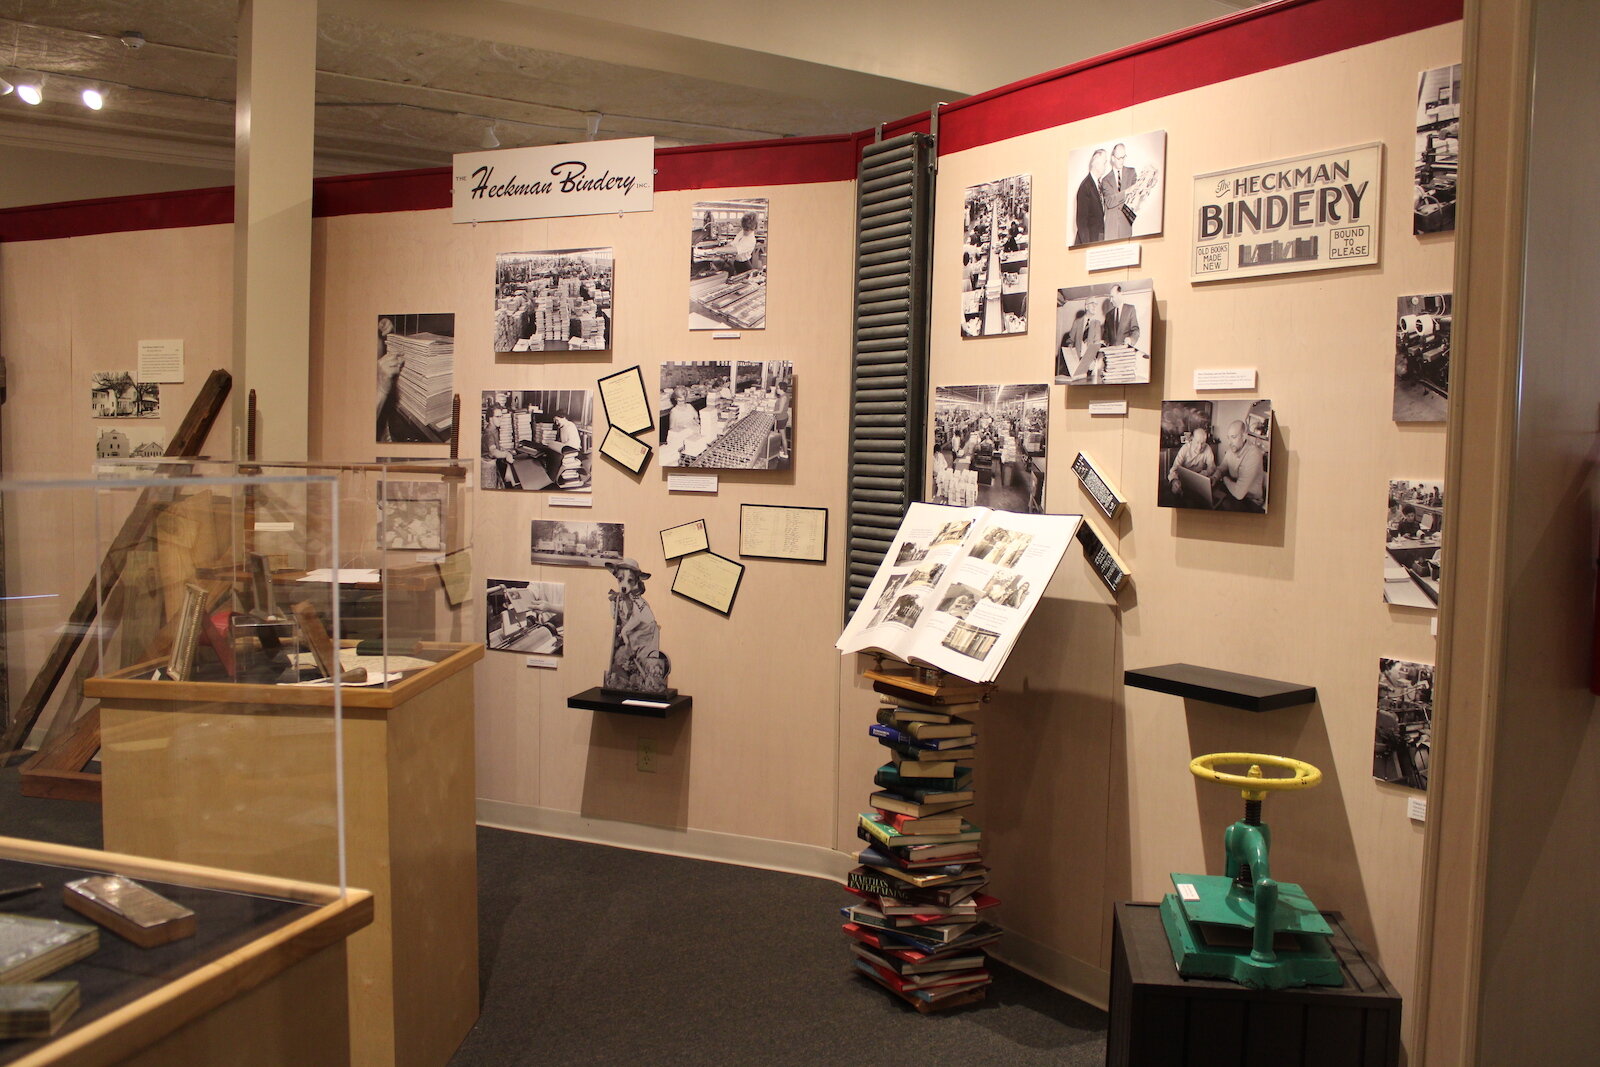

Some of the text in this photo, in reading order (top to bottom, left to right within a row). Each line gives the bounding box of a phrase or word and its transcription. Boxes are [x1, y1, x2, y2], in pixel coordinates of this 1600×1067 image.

[471, 166, 552, 199] Heckman
[550, 161, 636, 196] Bindery
[1215, 159, 1350, 197] The HECKMAN
[1199, 180, 1369, 240] BINDERY
[1334, 228, 1364, 240] BOUND
[1343, 238, 1355, 247] TO
[1198, 245, 1228, 256] OLD BOOKS
[1331, 246, 1367, 257] PLEASE
[1203, 253, 1222, 263] MADE
[1203, 262, 1222, 271] NEW
